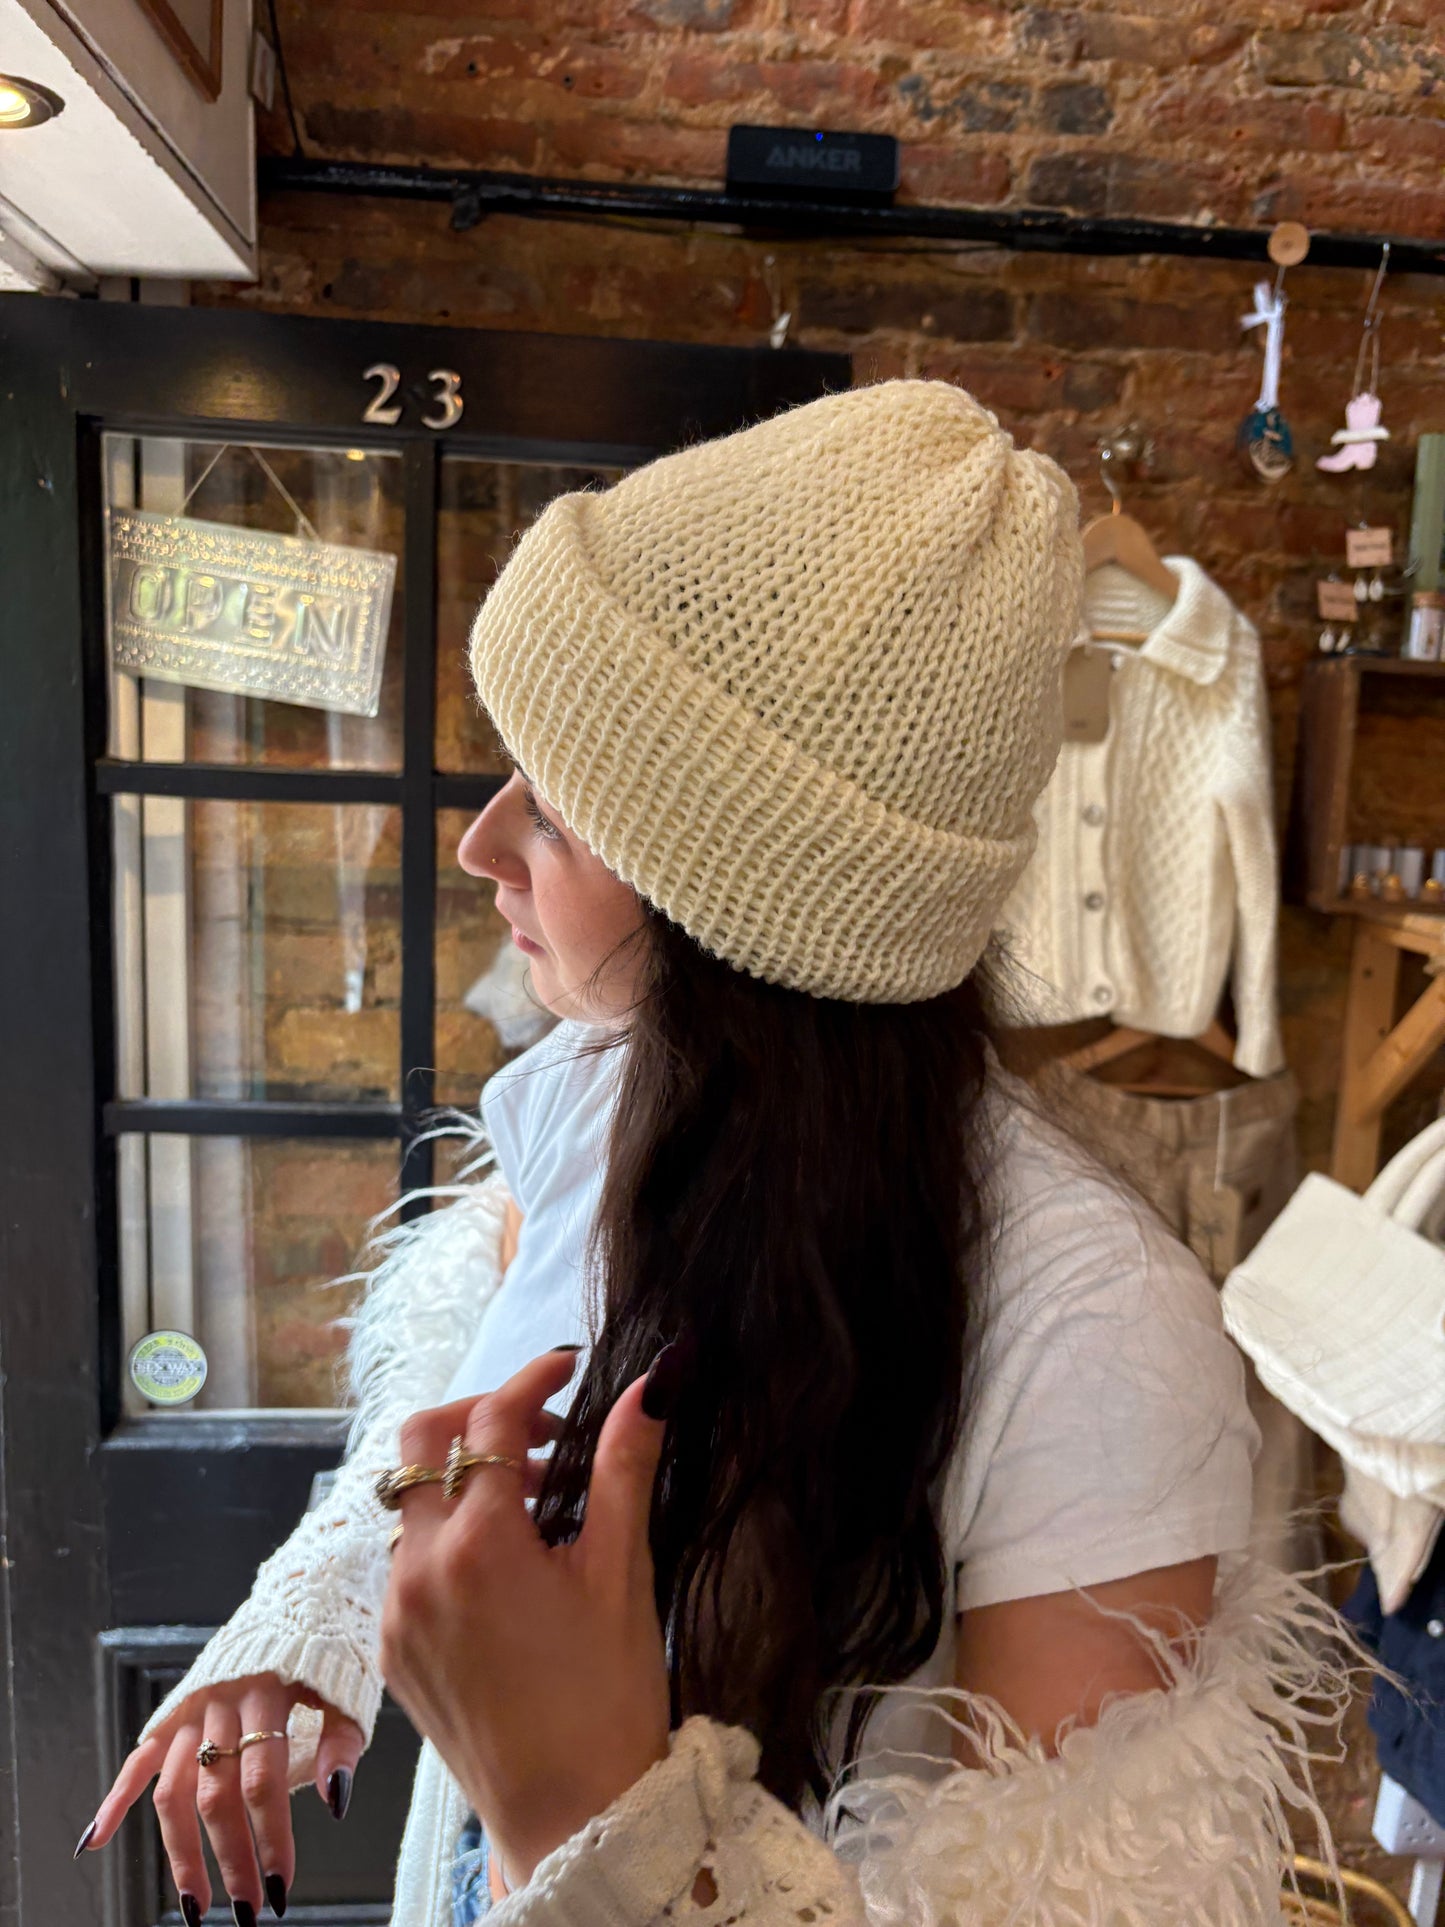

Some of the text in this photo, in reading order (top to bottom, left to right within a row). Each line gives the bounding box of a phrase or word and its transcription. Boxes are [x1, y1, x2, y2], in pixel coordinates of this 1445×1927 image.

[766, 144, 862, 172] ANKER
[362, 363, 465, 430] 23
[129, 563, 350, 660] OPEN
